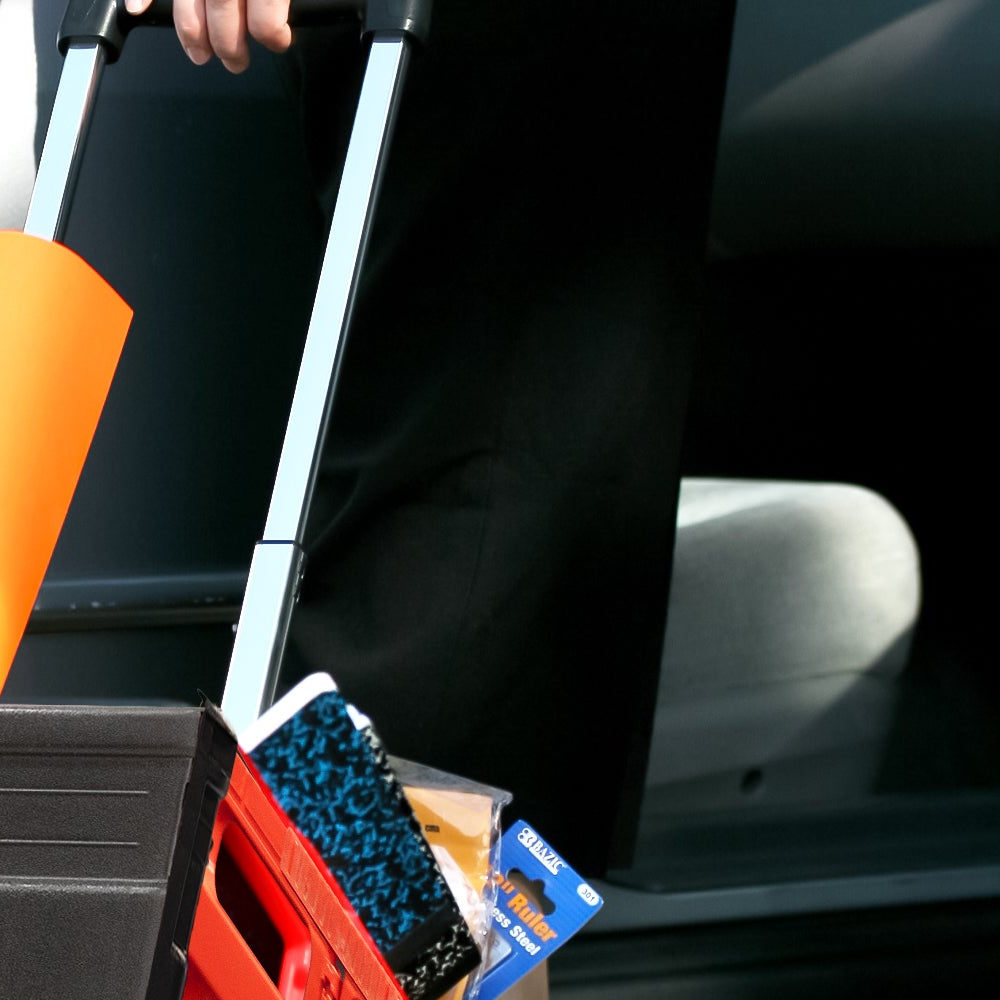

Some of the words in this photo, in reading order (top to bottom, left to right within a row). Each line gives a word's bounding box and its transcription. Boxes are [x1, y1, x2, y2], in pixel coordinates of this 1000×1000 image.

[532, 839, 563, 872] BAZIC
[493, 907, 511, 928] ess
[509, 925, 541, 956] Steel
[507, 892, 558, 943] Ruler
